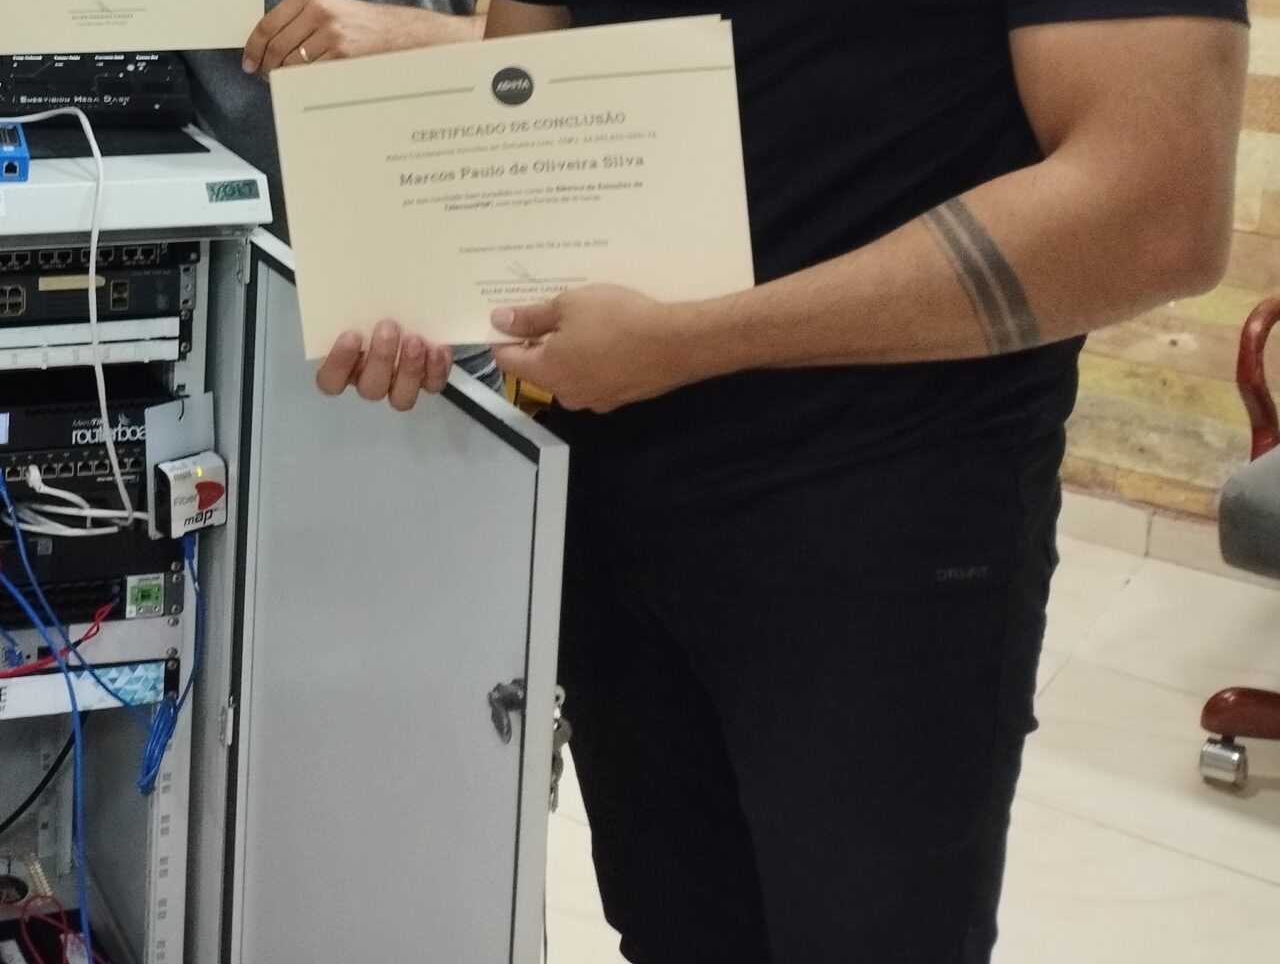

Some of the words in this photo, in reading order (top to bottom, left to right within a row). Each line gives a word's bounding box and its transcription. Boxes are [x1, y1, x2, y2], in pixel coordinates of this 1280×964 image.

[410, 122, 506, 143] CERTIFICADO
[510, 119, 531, 133] DE
[532, 111, 626, 131] CONCLUSÃO
[400, 170, 456, 187] Marcos
[460, 164, 505, 180] Paulo
[509, 161, 529, 175] de
[532, 158, 598, 174] Oliveira
[601, 154, 644, 170] Silva
[72, 423, 147, 445] routrboa
